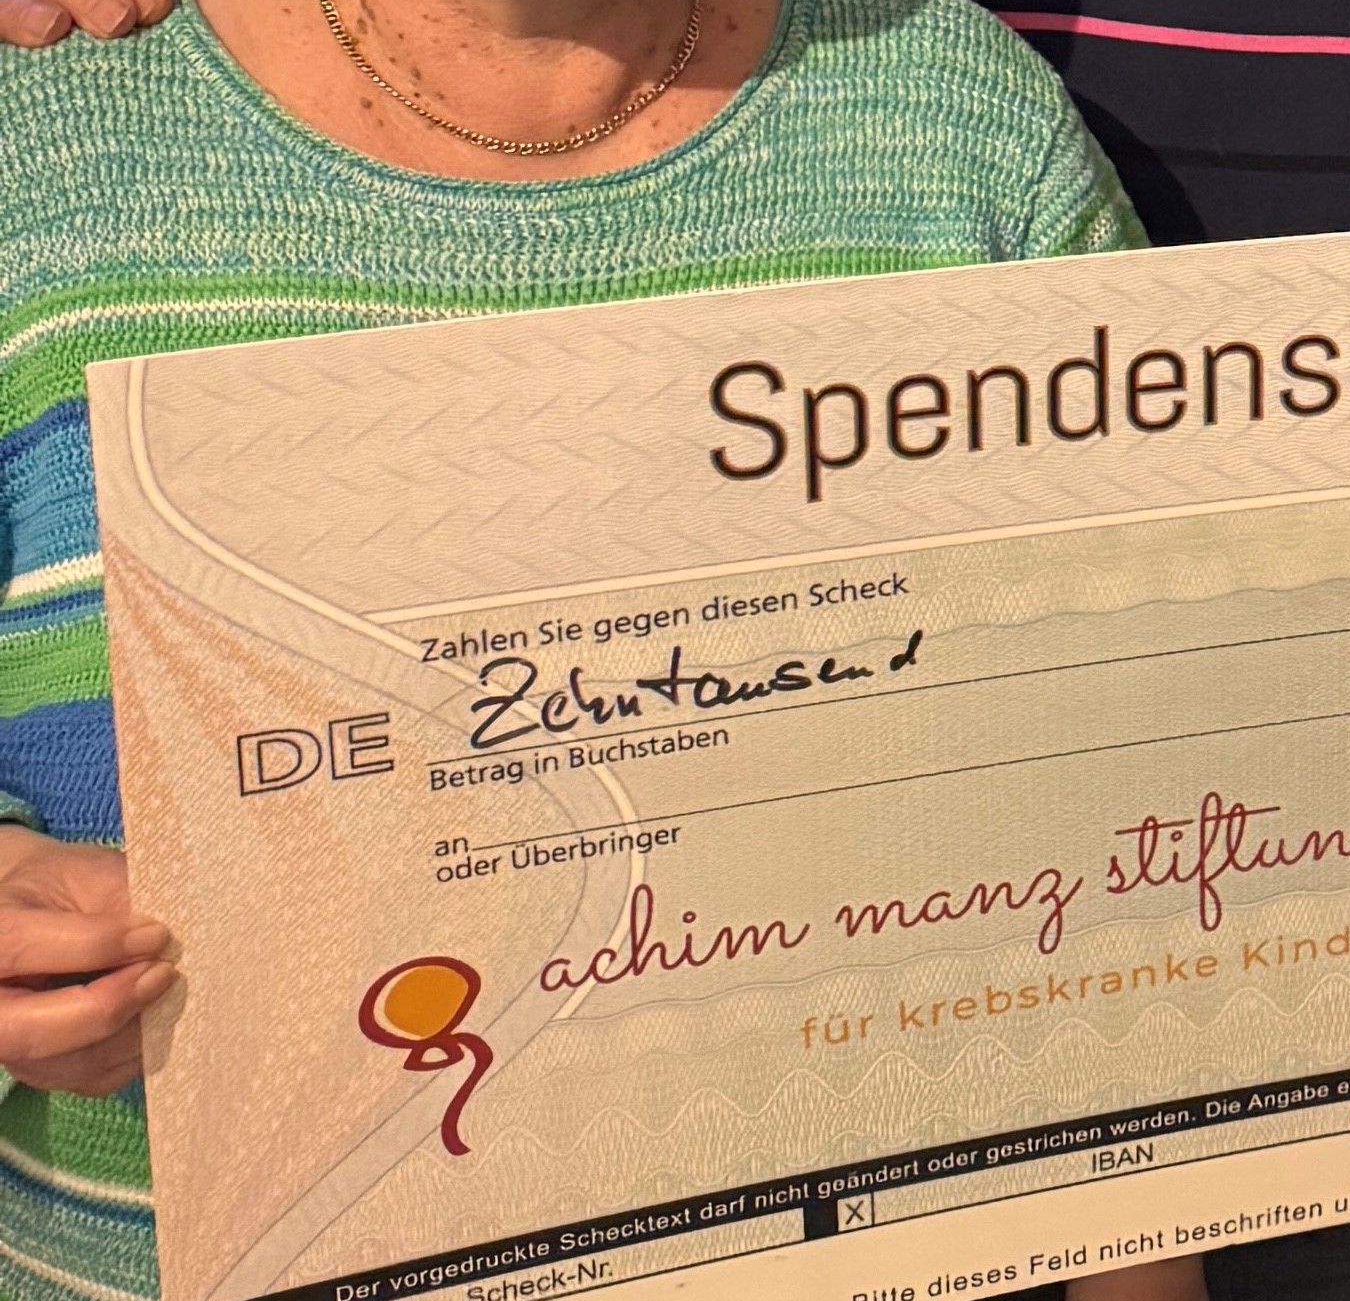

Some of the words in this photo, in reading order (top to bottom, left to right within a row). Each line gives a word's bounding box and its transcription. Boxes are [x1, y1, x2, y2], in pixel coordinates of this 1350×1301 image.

[420, 626, 527, 664] Zahlen
[538, 618, 584, 646] Sie
[594, 603, 691, 642] gegen
[700, 587, 798, 623] diesen
[808, 572, 909, 607] Scheck
[469, 630, 923, 750] Zehntausend
[236, 711, 396, 797] DE
[429, 756, 525, 792] Betrag
[533, 750, 560, 777] in
[567, 725, 731, 770] Buchstaben
[433, 833, 470, 859] an
[435, 853, 503, 884] oder
[510, 824, 683, 871] Überbringer
[538, 884, 810, 994] achim
[834, 875, 1082, 953] manz
[800, 1011, 873, 1049] für
[897, 950, 1221, 1033] krebskranke
[388, 1239, 551, 1292] vorgedruckte
[558, 1207, 693, 1253] Schecktext
[698, 1193, 749, 1223] darf
[754, 1182, 810, 1209] nicht
[818, 1160, 920, 1200] geändert
[926, 1147, 979, 1175] oder
[985, 1122, 1103, 1163] gestrichen
[1109, 1108, 1198, 1138] werden.
[1205, 1096, 1242, 1119] Die
[1247, 1082, 1331, 1114] Angabe
[1090, 1140, 1155, 1174] IBAN
[926, 1260, 1019, 1299] dieses
[1028, 1243, 1089, 1276] Feld
[1098, 1228, 1166, 1261] nicht
[1174, 1198, 1325, 1246] beschriften
